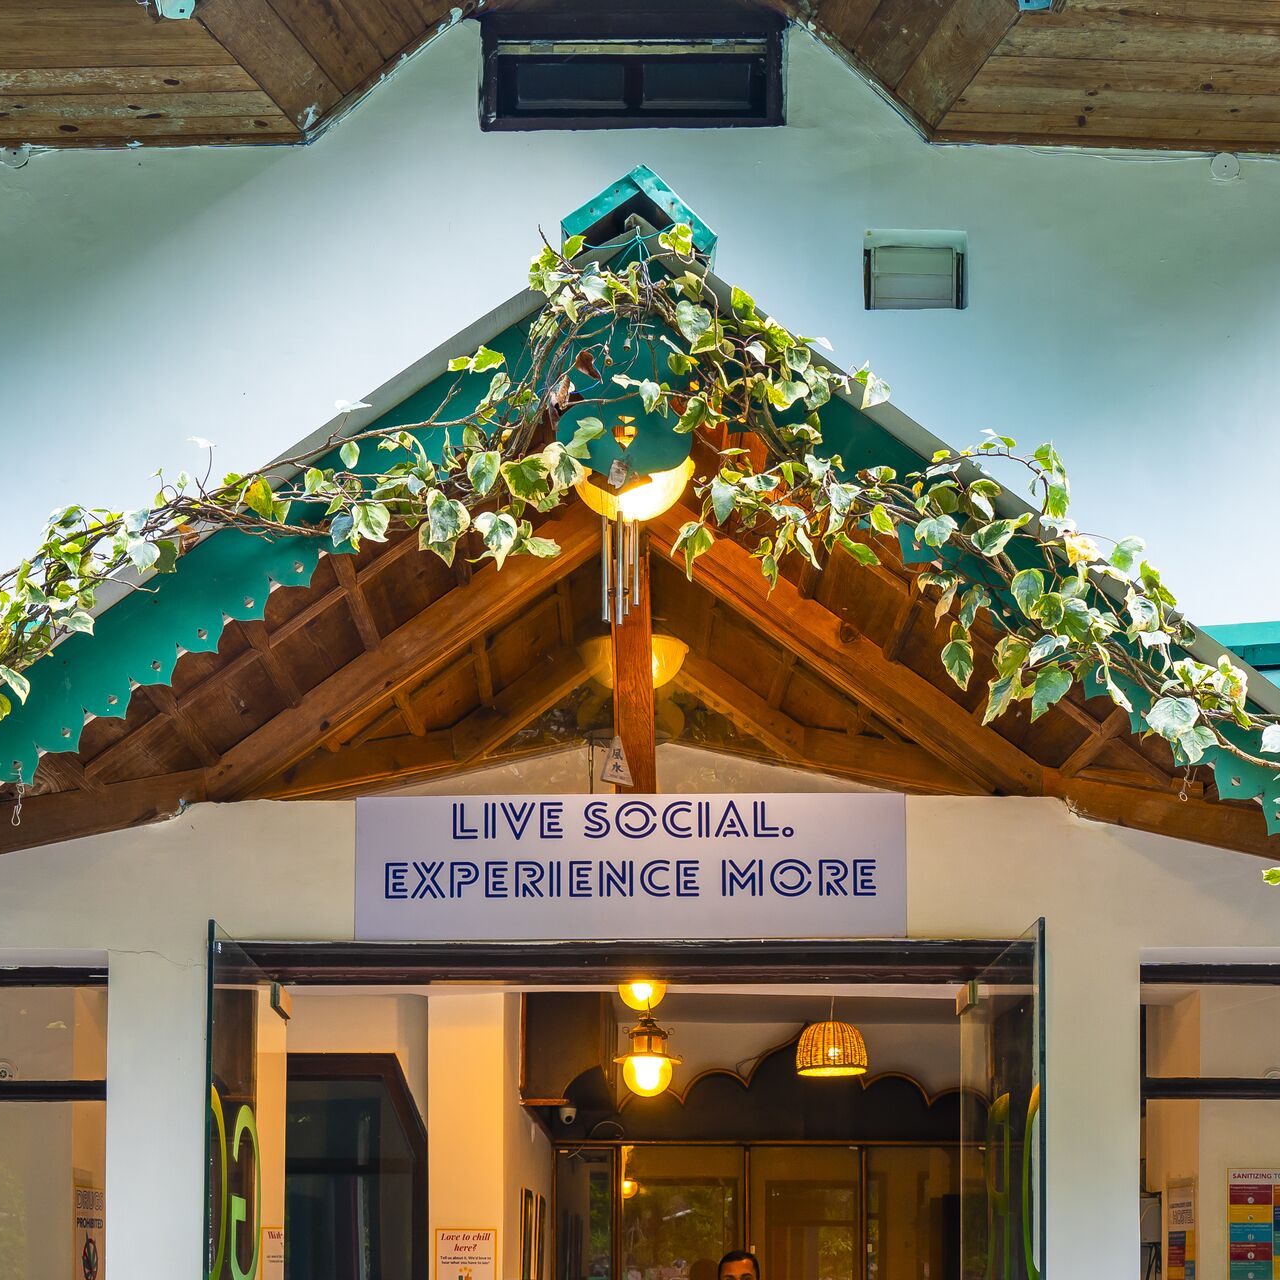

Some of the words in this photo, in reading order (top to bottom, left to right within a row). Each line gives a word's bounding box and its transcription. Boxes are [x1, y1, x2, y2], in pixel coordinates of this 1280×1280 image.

[451, 801, 564, 840] LIVE
[583, 801, 794, 840] SOCIAL.
[384, 858, 701, 899] EXPERIENCE
[720, 858, 877, 899] MORE
[1232, 1172, 1272, 1180] SANITIZING
[76, 1217, 104, 1228] PROHIBITED
[440, 1232, 461, 1241] Love
[462, 1232, 471, 1241] to
[472, 1232, 491, 1241] chill
[453, 1243, 478, 1251] here?
